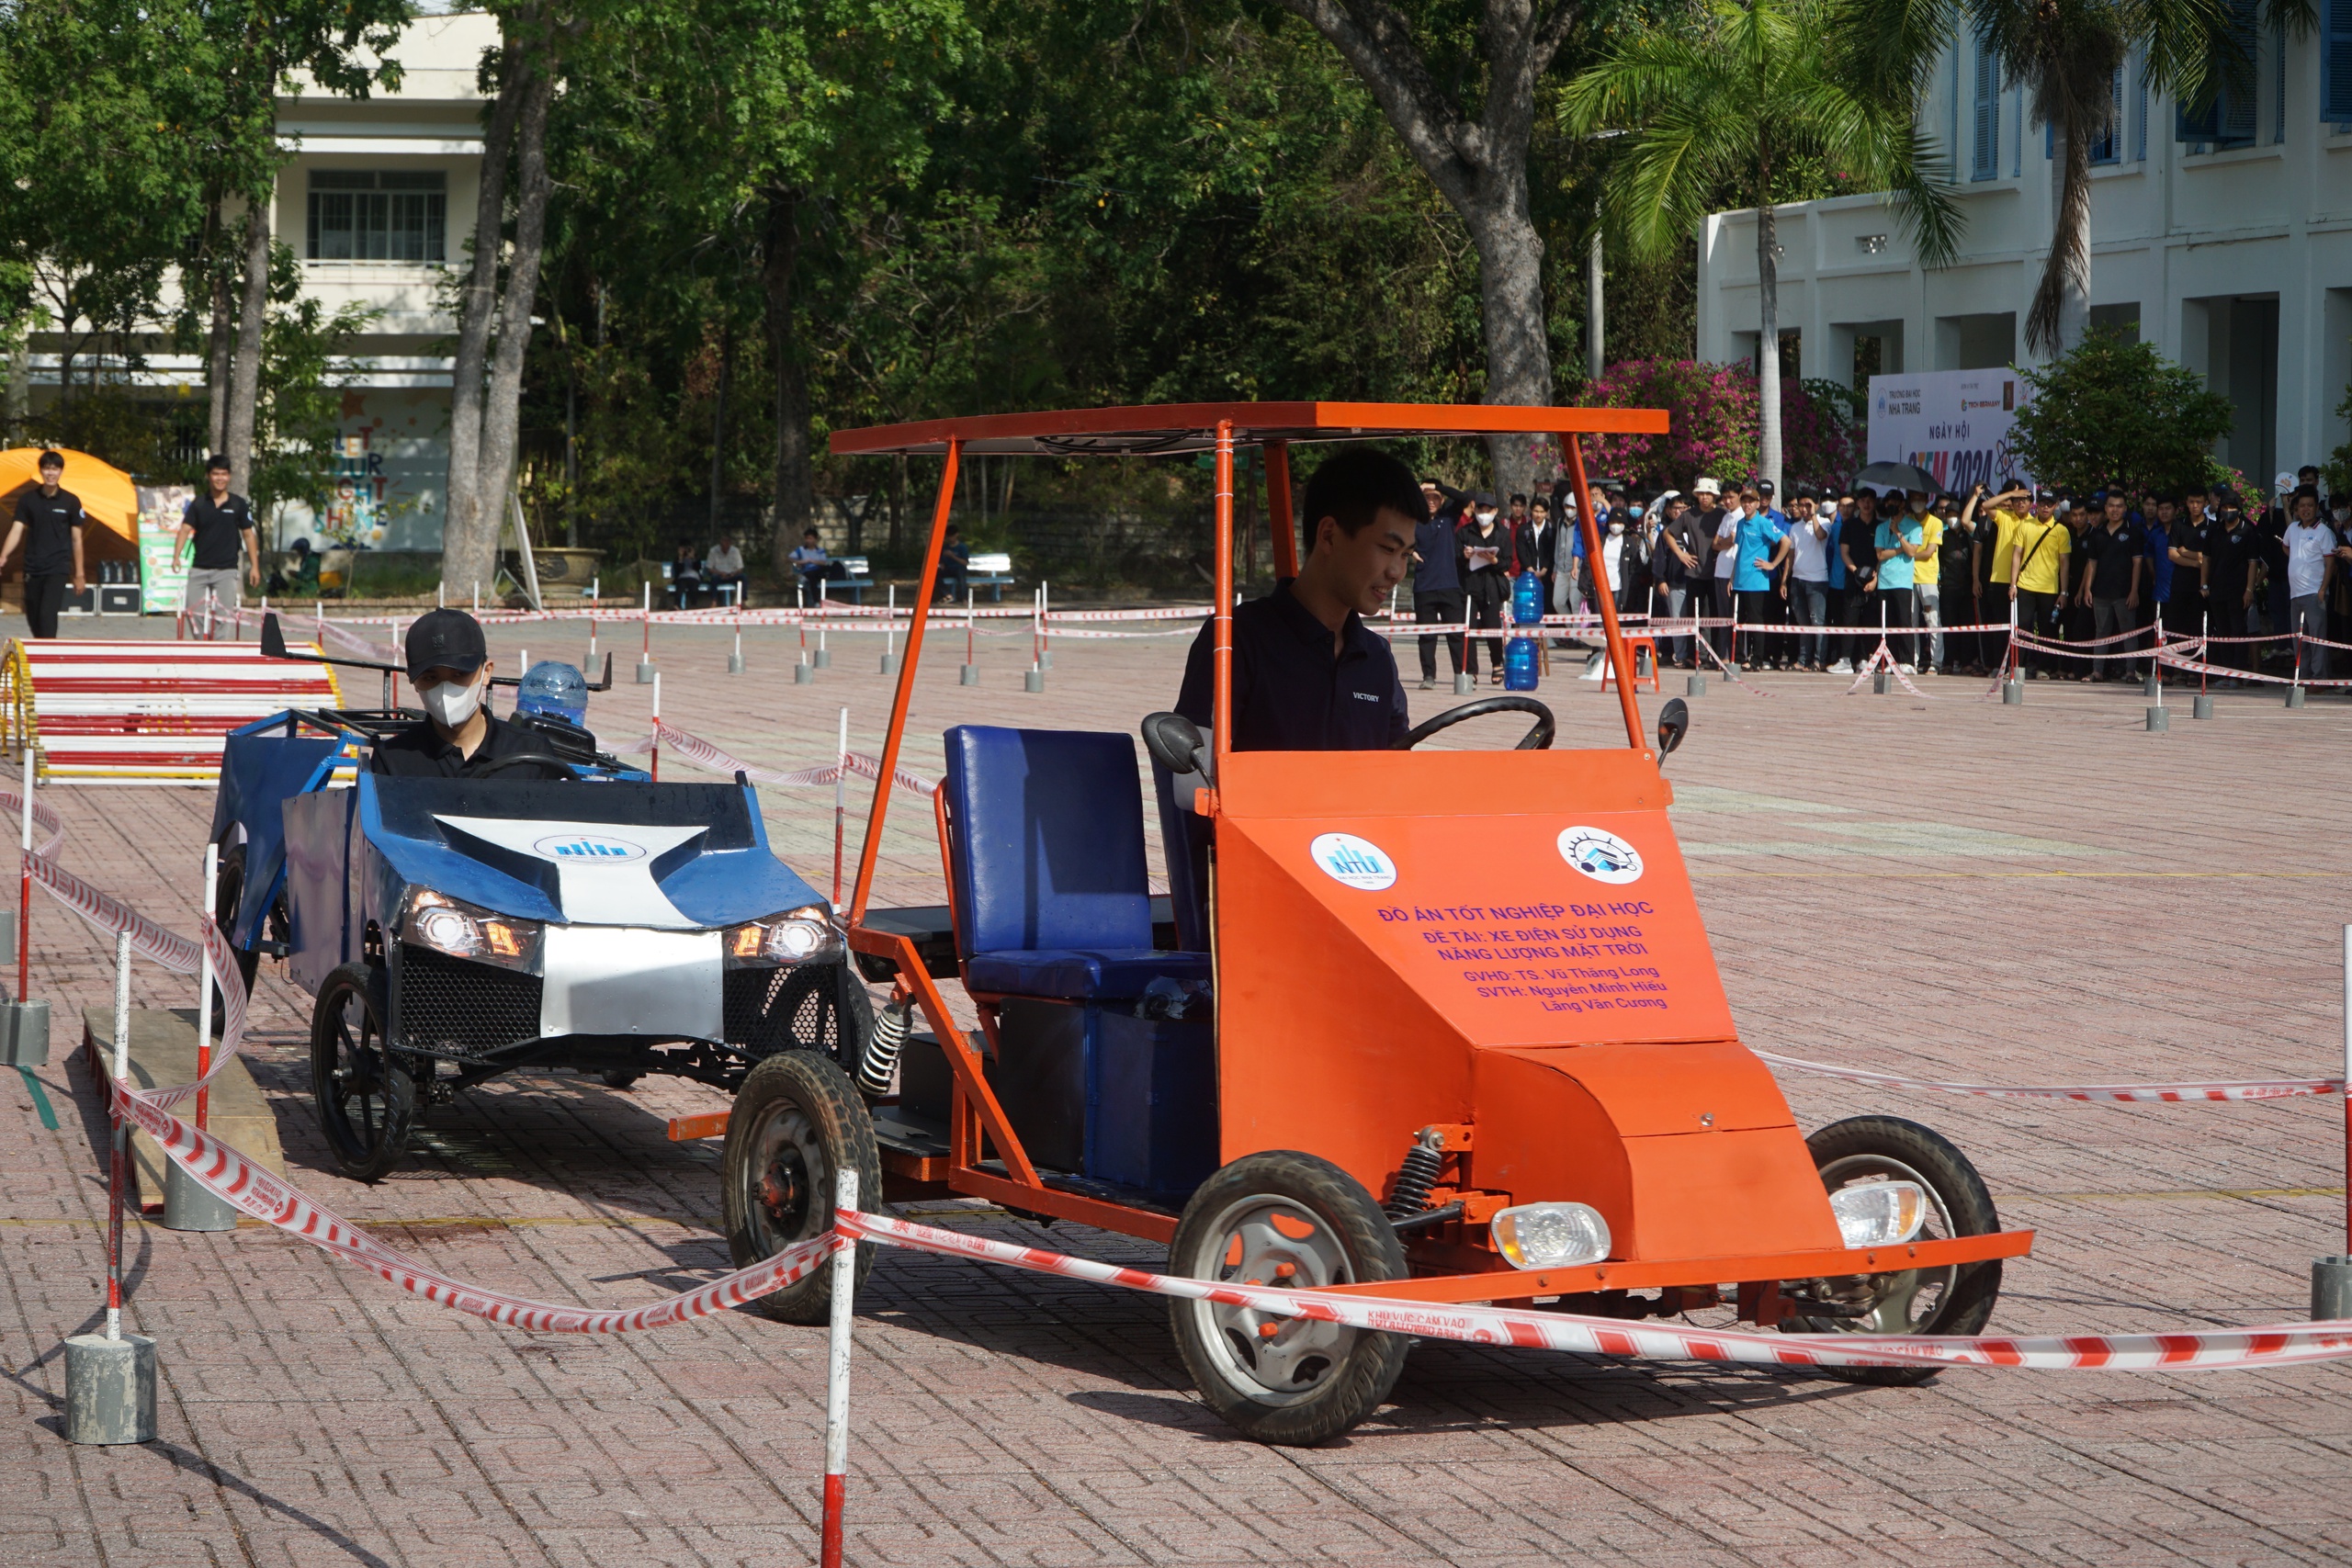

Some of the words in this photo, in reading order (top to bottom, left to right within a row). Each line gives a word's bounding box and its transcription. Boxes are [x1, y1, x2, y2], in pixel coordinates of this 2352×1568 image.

[1889, 403, 1900, 415] NHA
[1902, 401, 1921, 414] TRANG
[1929, 422, 1952, 439] NGÀY
[1956, 420, 1970, 442] HỘI
[335, 426, 373, 457] LET
[1352, 692, 1379, 703] VICTORY
[1335, 862, 1379, 874] NTU
[1377, 905, 1409, 921] ĐỒ
[1414, 906, 1445, 921] ÁN
[1443, 904, 1486, 920] TỐT
[1488, 902, 1565, 920] NGHIỆP
[1569, 903, 1607, 919] ĐẠI
[1608, 901, 1654, 917] HỌC
[1422, 928, 1450, 943] ĐỀ
[1448, 928, 1487, 942] TÀI:
[1487, 931, 1515, 942] XE
[1515, 927, 1561, 942] ĐIỆN
[1561, 924, 1588, 940] SỬ
[1589, 925, 1643, 940] DỤNG
[1437, 946, 1493, 961] NĂNG
[1494, 945, 1560, 961] LƯỢNG
[1561, 942, 1601, 959] MẶT
[1602, 941, 1648, 955] TRỜI
[1464, 970, 1516, 982] GVHD:
[1515, 969, 1544, 980] TS.
[1544, 968, 1568, 979] Vũ
[1567, 967, 1620, 979] Thăng
[1619, 966, 1660, 977] Long
[1477, 986, 1528, 998] SVTH:
[1528, 982, 1589, 998] Nguyễn
[1589, 981, 1630, 994] Minh
[1630, 979, 1668, 992] Hiếu
[1541, 1000, 1583, 1012] Lăng
[1581, 998, 1614, 1010] Văn
[1615, 998, 1668, 1010] Cương
